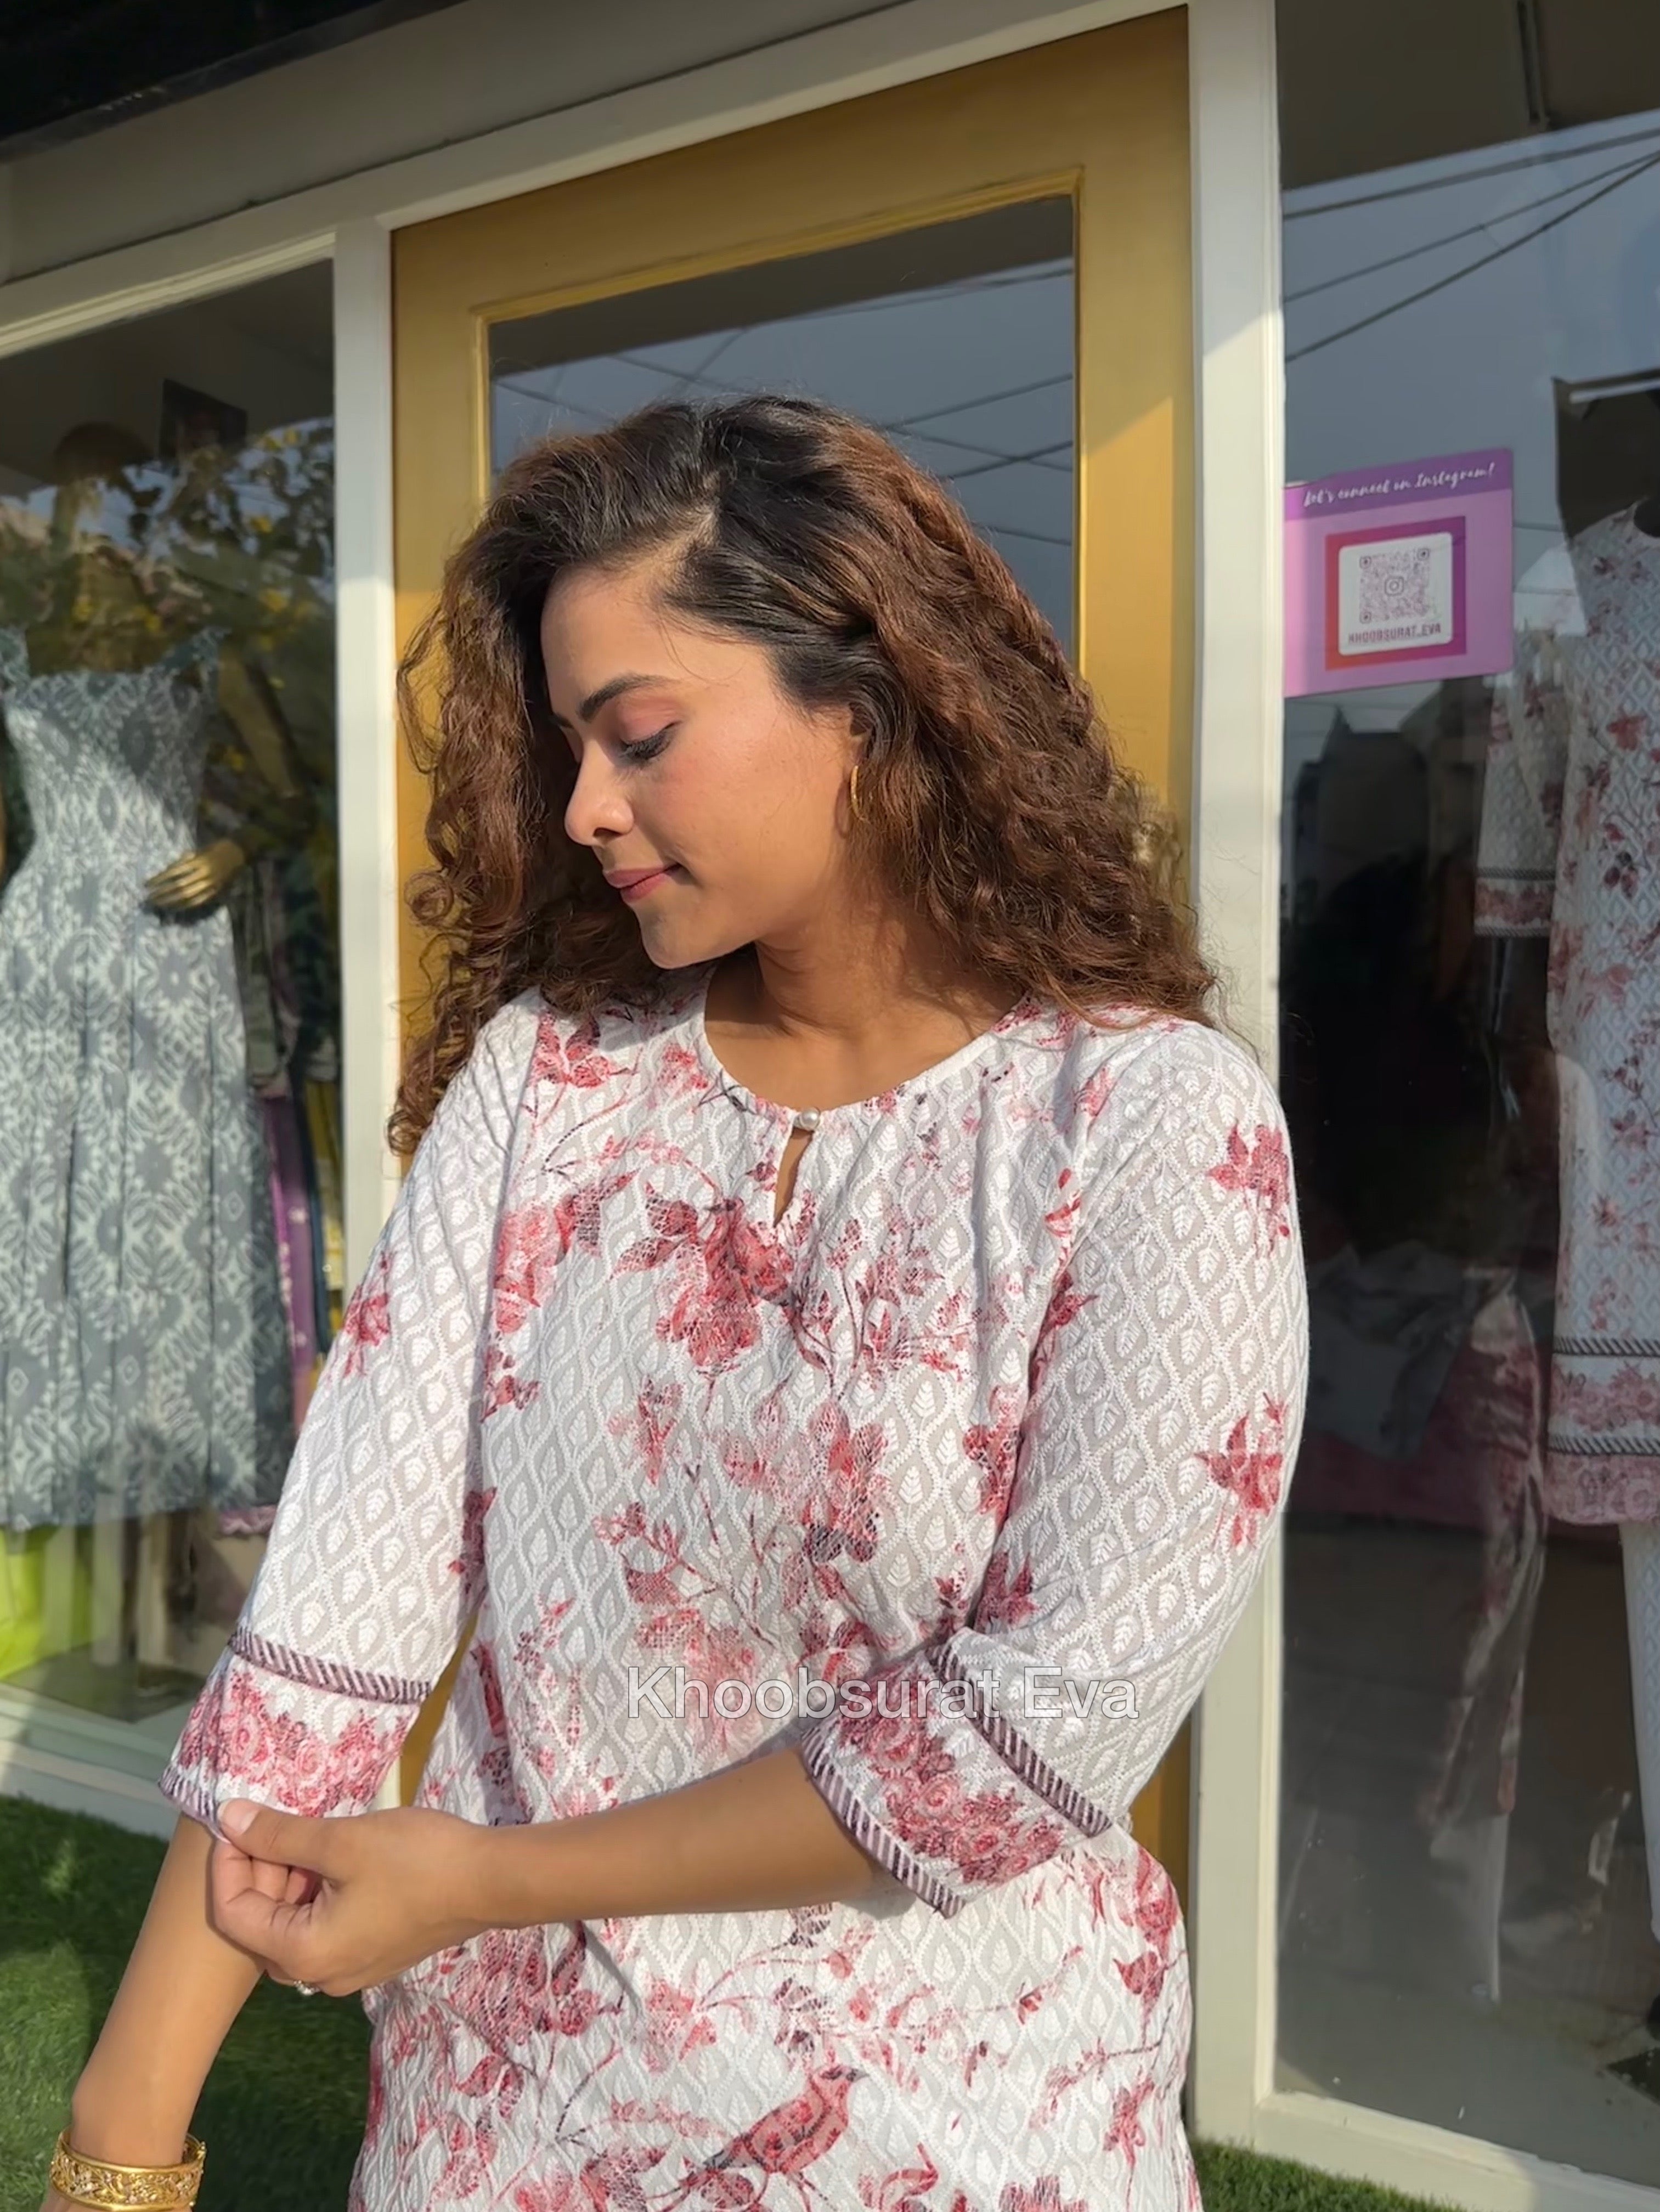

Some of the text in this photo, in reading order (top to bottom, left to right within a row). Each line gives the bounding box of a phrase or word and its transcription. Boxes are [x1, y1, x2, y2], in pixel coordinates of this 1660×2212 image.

[1337, 479, 1390, 499] connect
[1393, 481, 1411, 492] on
[1415, 461, 1495, 489] Instagram!
